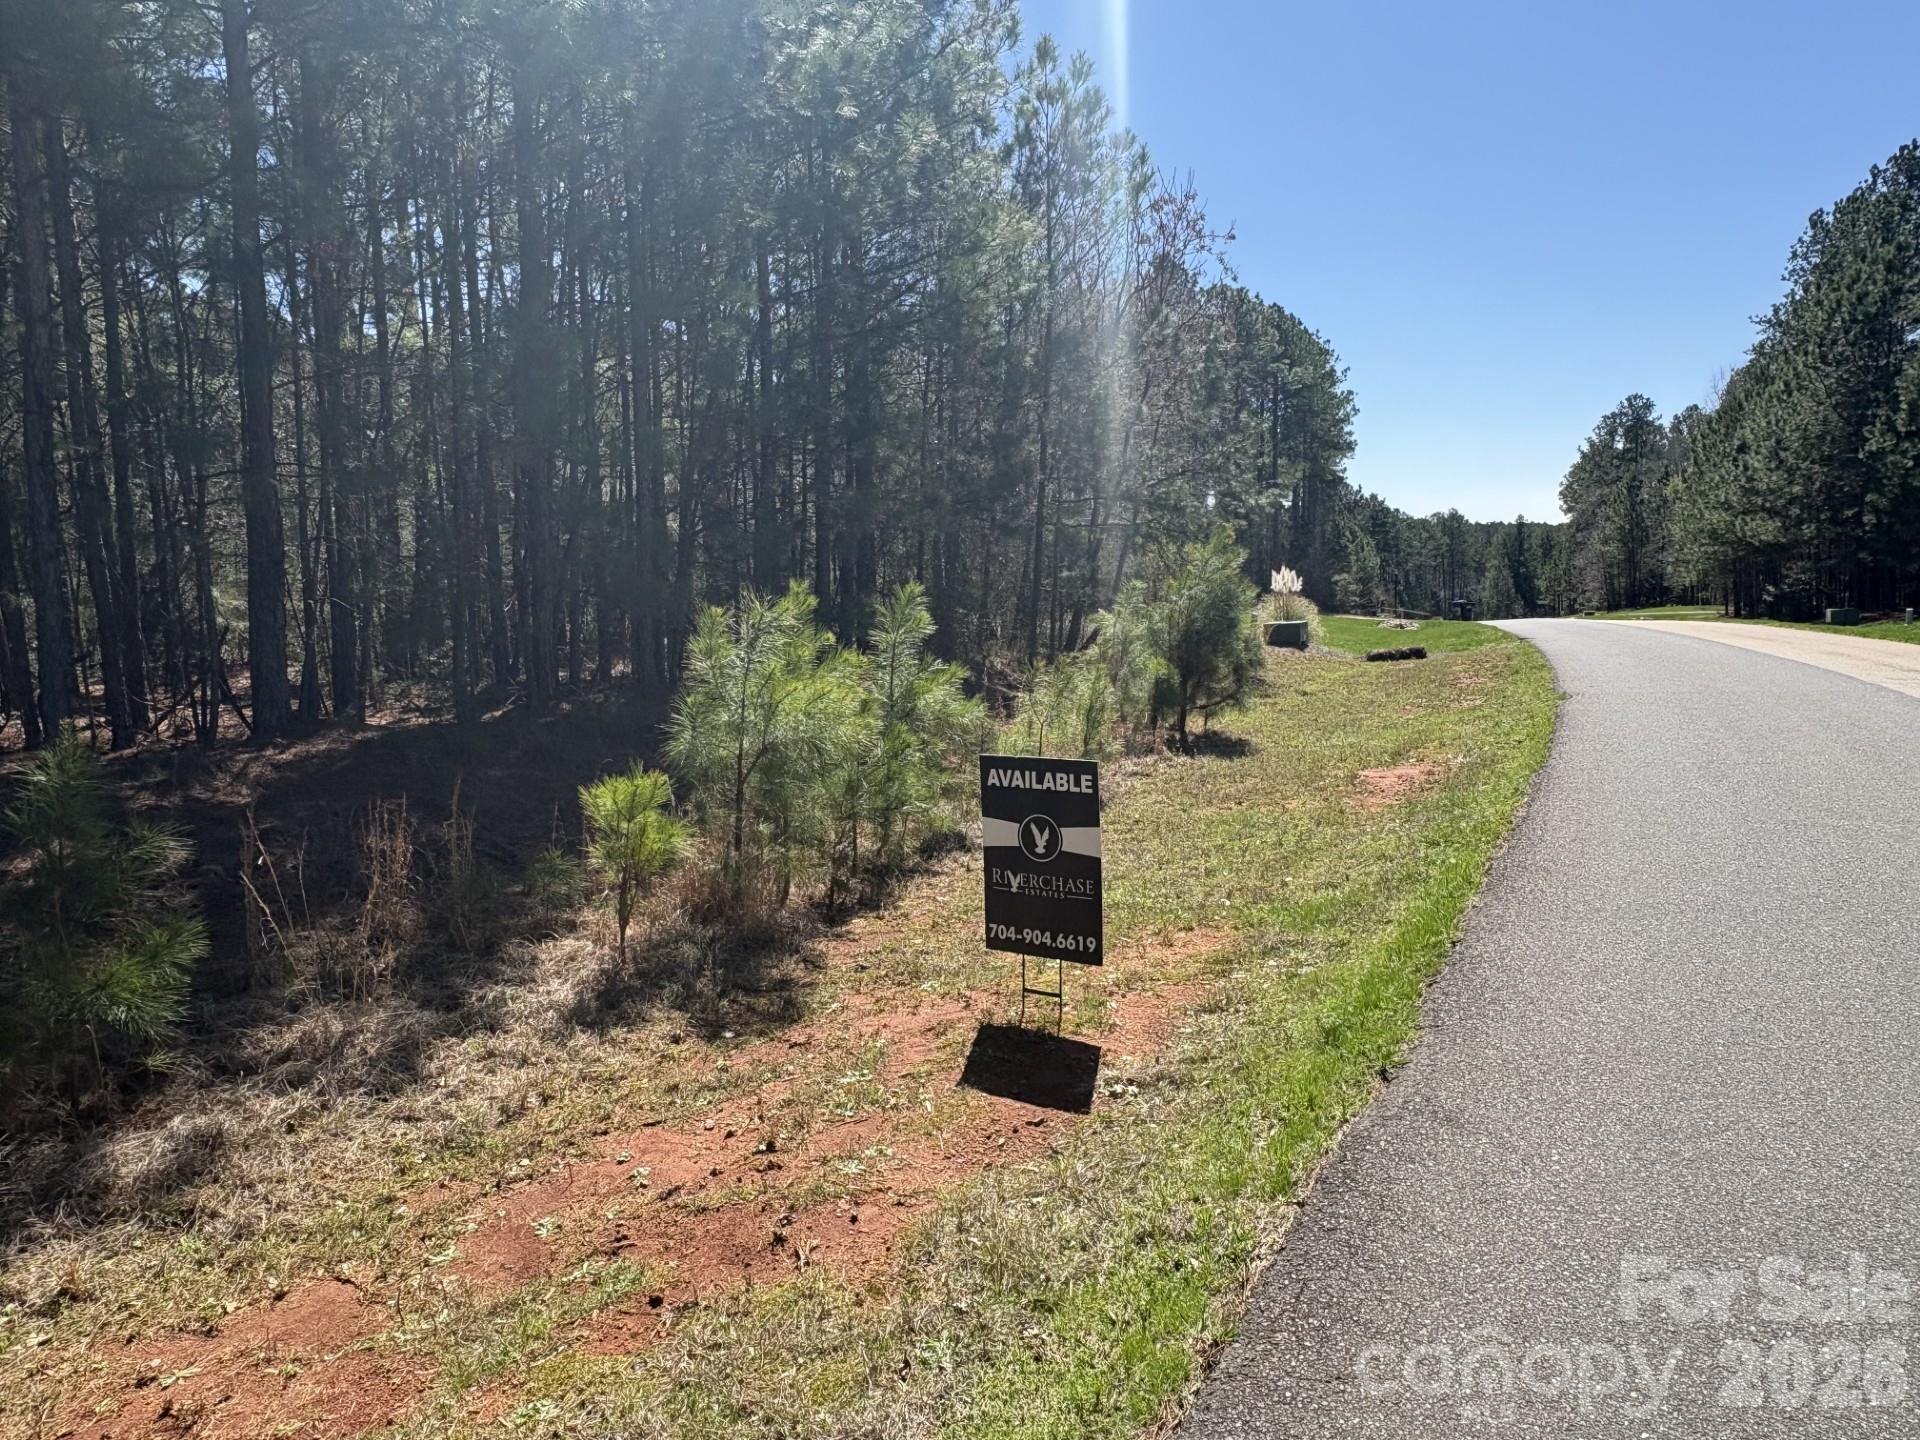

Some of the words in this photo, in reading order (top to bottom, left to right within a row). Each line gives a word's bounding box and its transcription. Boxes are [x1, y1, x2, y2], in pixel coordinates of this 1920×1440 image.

[987, 768, 1093, 794] AVAILABLE
[1025, 887, 1065, 899] ESTATES
[989, 923, 1096, 953] 704-904.6619
